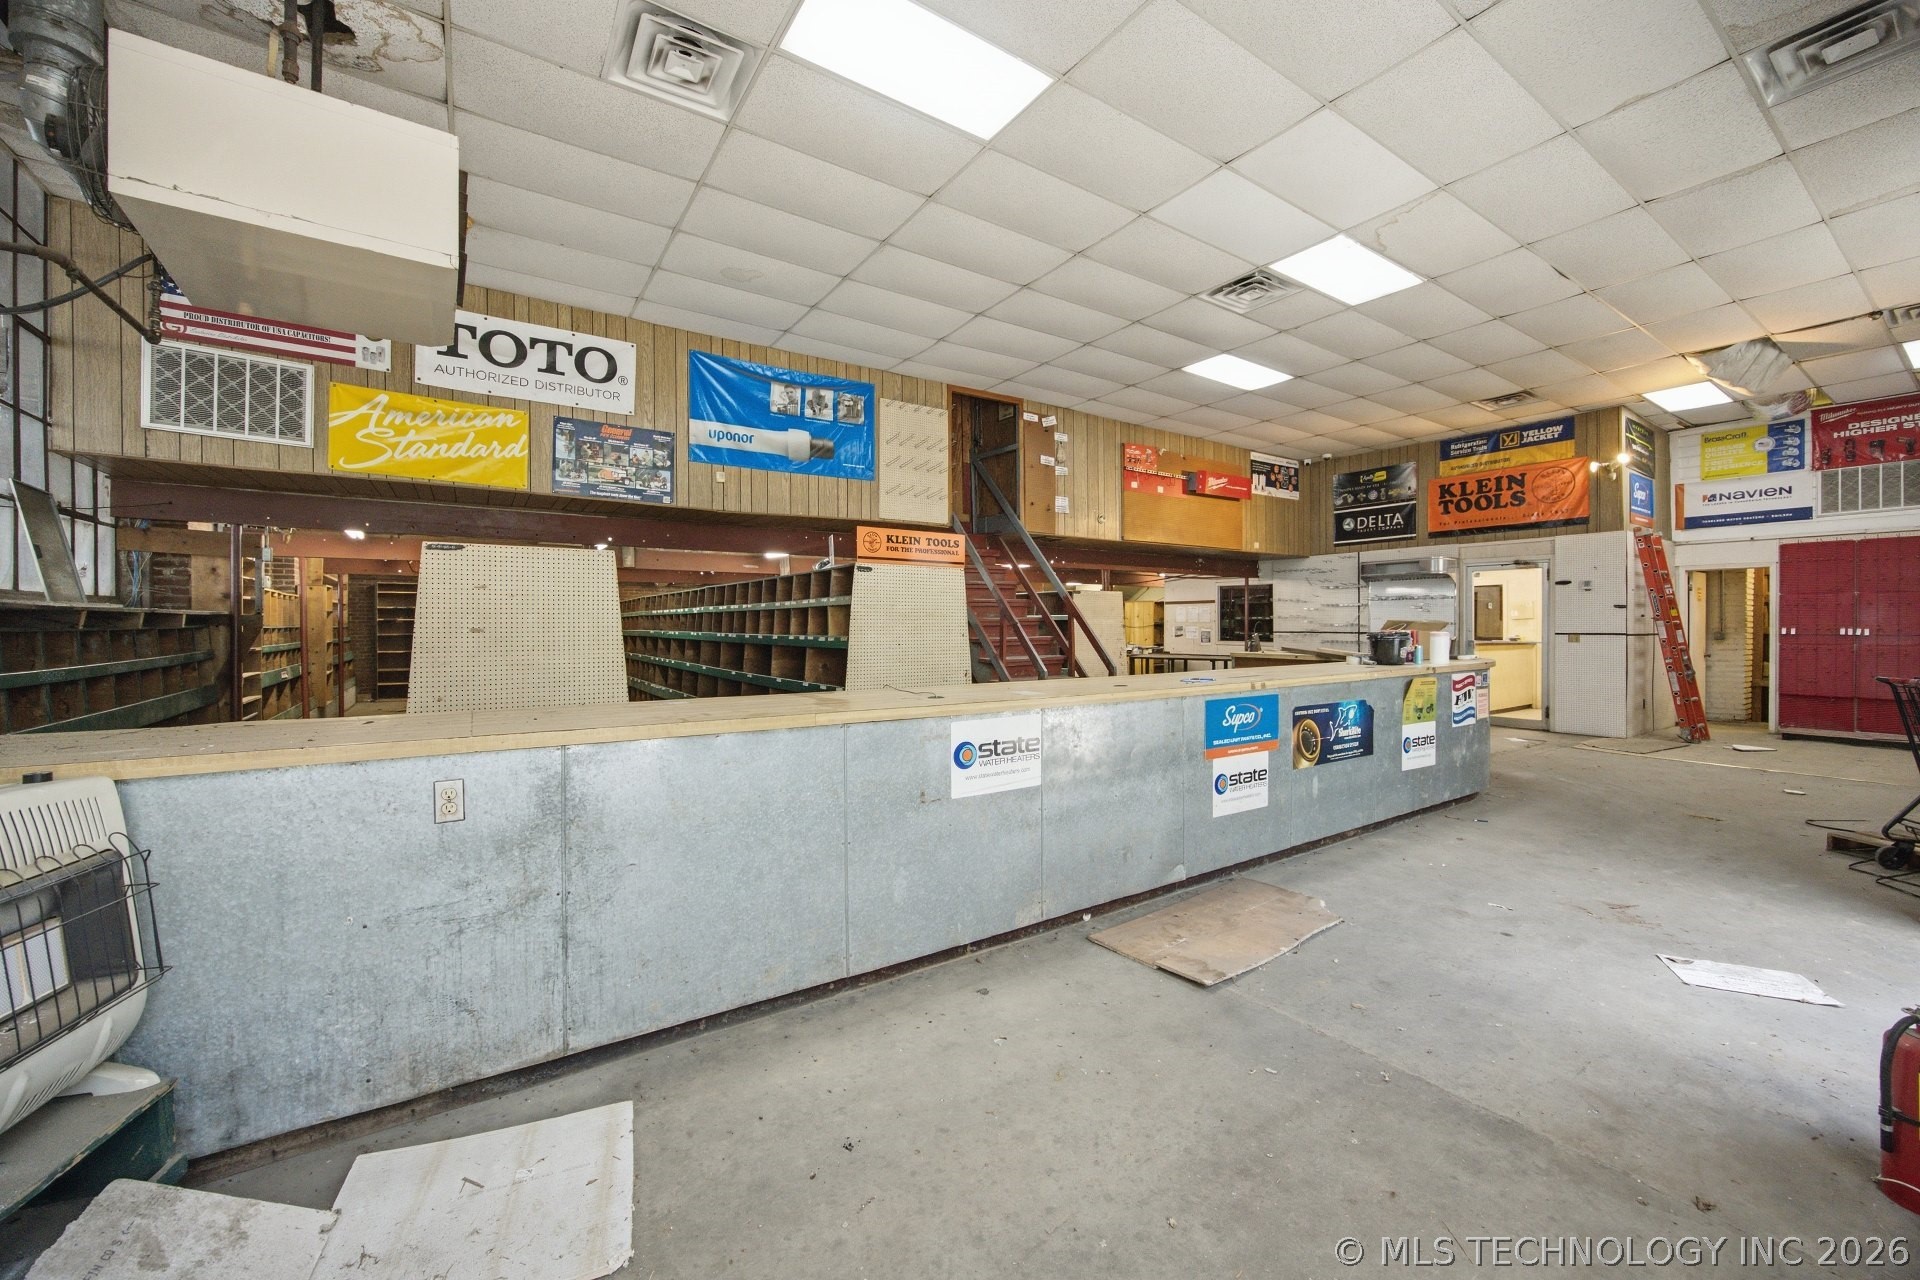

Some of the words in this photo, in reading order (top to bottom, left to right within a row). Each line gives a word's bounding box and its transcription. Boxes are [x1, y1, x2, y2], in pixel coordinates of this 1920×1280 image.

[183, 311, 210, 322] PROUD
[211, 316, 260, 331] DISTRIBUTOR
[272, 327, 286, 335] USA
[287, 330, 331, 342] CAPACITORS!
[437, 322, 618, 384] TOTO
[434, 363, 529, 387] AUTHORIZED
[535, 379, 621, 401] DISTRIBUTOR
[329, 393, 521, 433] American
[1819, 407, 1857, 422] Milwaukee
[708, 429, 755, 443] uponor
[1521, 424, 1564, 437] YELLOW
[1521, 431, 1560, 444] JACKET
[1704, 431, 1747, 443] BrassCraft
[1833, 423, 1898, 439] HIGHER
[338, 427, 529, 469] Standard
[1502, 433, 1518, 446] YJ
[1438, 472, 1528, 500] KLEIN
[1438, 490, 1527, 515] TOOLS
[1357, 512, 1404, 530] DELTA
[886, 534, 921, 545] KLEIN
[925, 537, 960, 549] TOOLS
[914, 547, 960, 556] PROFESSIONAL
[1222, 704, 1256, 734] Supco
[978, 736, 1041, 759] state
[1411, 734, 1436, 748] state
[978, 757, 1006, 767] WATER
[1006, 752, 1041, 764] HEATERS
[1229, 768, 1268, 787] state
